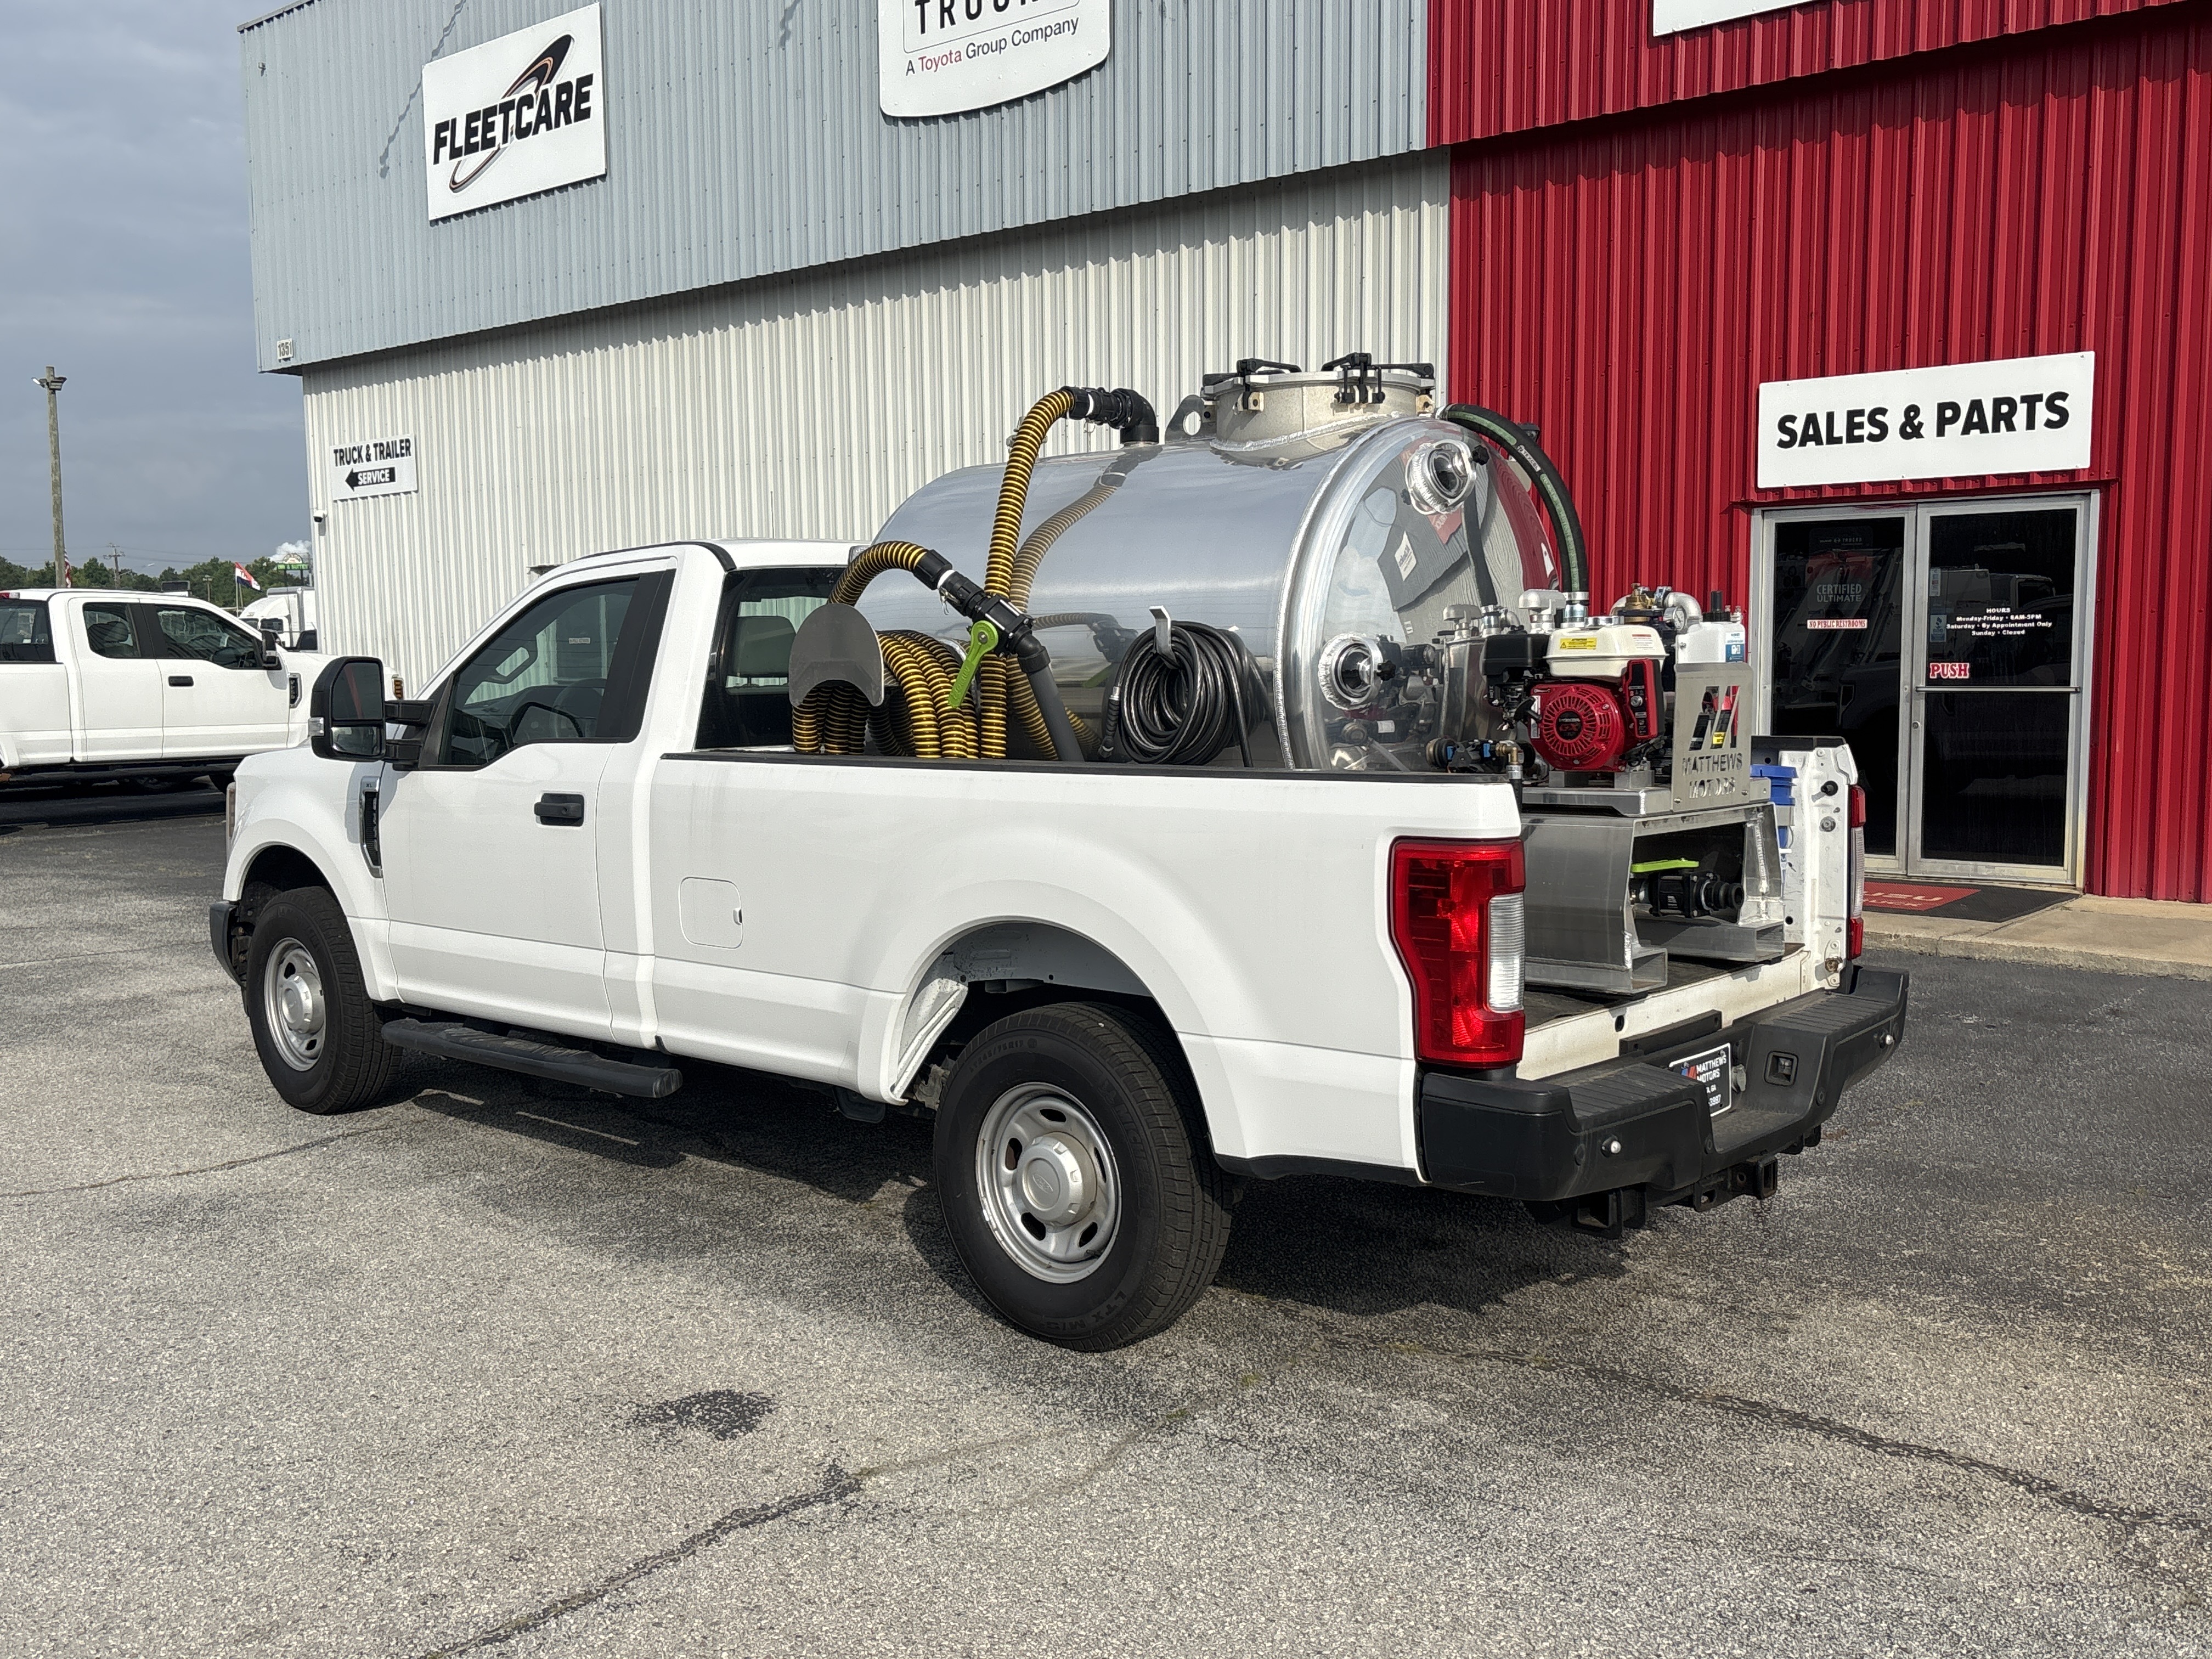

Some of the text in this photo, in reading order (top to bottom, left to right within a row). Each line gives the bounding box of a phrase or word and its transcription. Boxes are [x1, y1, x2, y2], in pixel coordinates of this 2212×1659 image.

[915, 0, 1041, 35] TRU
[906, 17, 1079, 76] A Toyota Group Company
[433, 73, 594, 165] FLEETCARE
[278, 342, 292, 357] 1351
[1776, 391, 2070, 449] SALES & PARTS
[334, 438, 411, 467] TRUCK & TRAILER
[358, 469, 390, 485] SERVICE
[1816, 583, 1862, 595] CERTIFIED
[1931, 664, 1968, 678] PUSH
[1682, 752, 1742, 776] MATTHEWS
[1689, 776, 1735, 799] MOTORS
[1696, 1054, 1727, 1074] MATTHEWS
[1696, 1068, 1720, 1083] MOTORS
